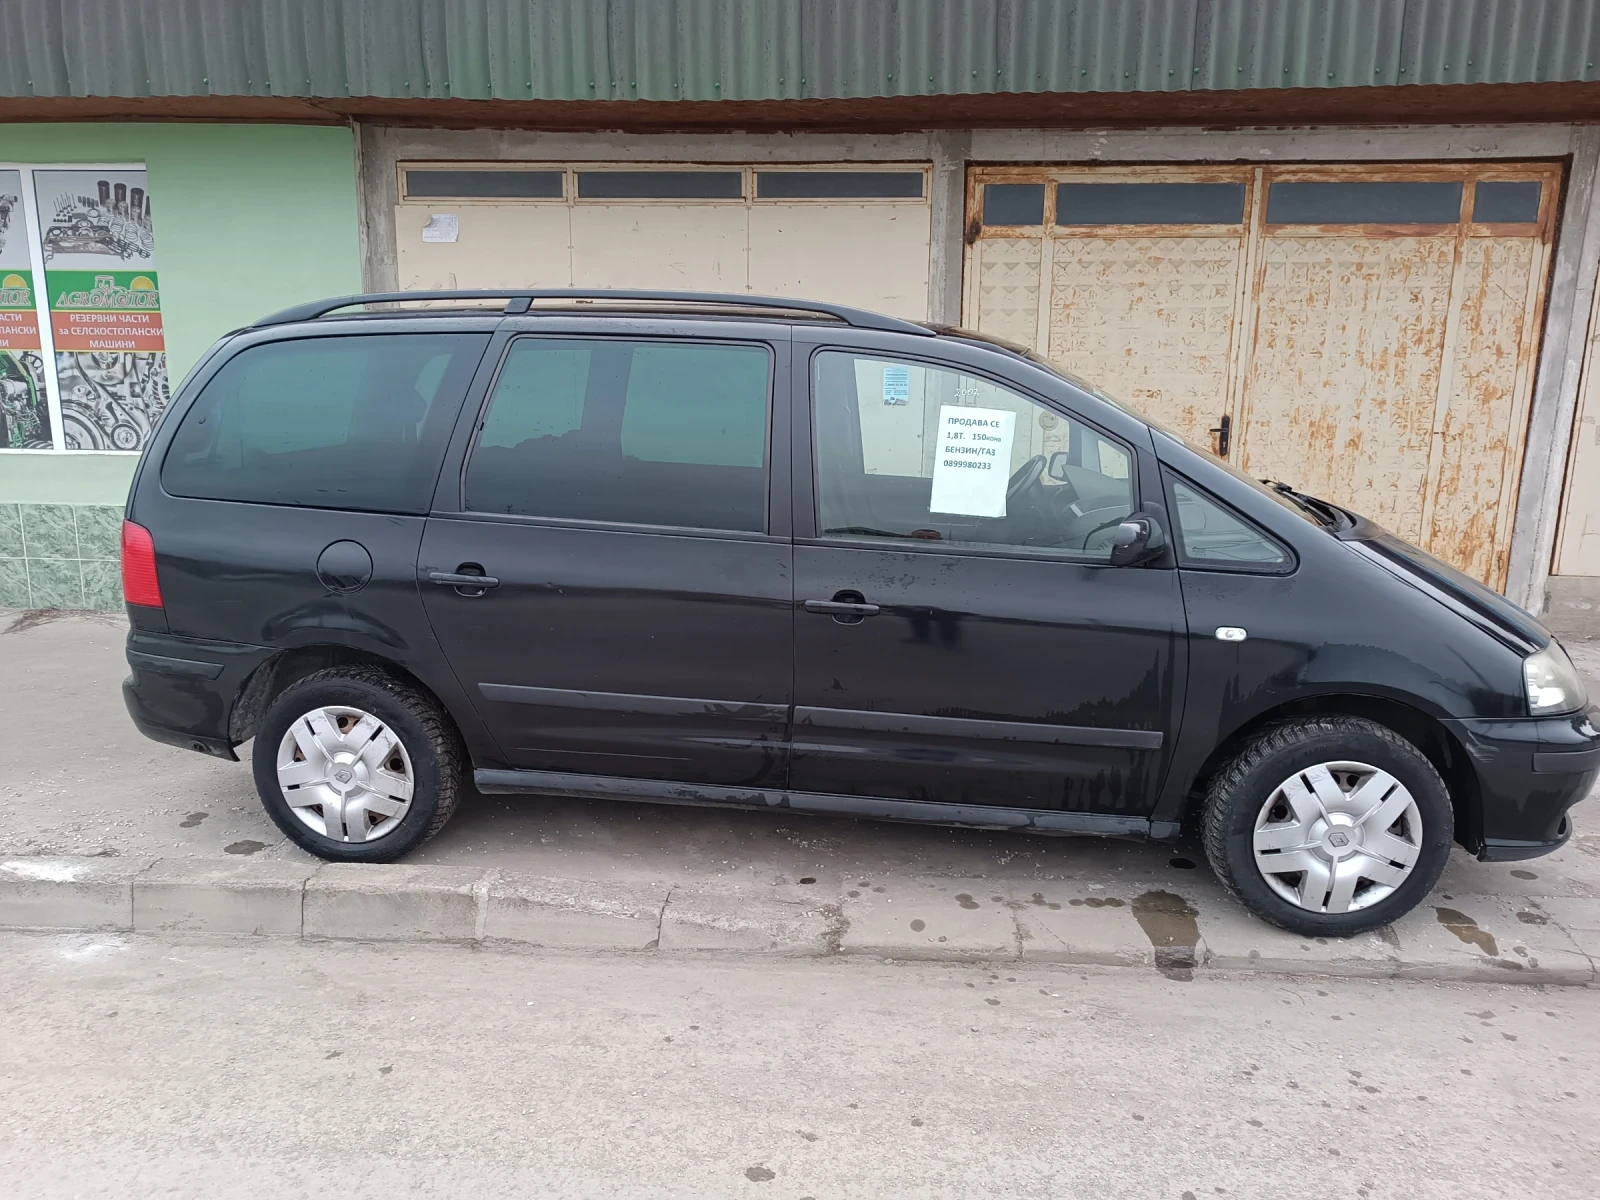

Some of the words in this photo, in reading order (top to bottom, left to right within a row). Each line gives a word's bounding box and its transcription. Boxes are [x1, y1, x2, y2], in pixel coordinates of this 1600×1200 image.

[0, 289, 31, 306] TOR
[55, 290, 160, 308] AGROMOTOR
[70, 314, 117, 322] РЕЗЕРВНИ
[119, 314, 149, 323] ЧАСТИ
[71, 327, 163, 336] СЕЛСКОСТОПАНСКИ
[89, 340, 136, 349] МАШИНИ
[948, 417, 989, 427] ПРОДАВА
[990, 420, 1000, 428] СЕ
[945, 445, 996, 456] БЕНЗИН/ГАЗ
[943, 459, 992, 470] 0899980233
